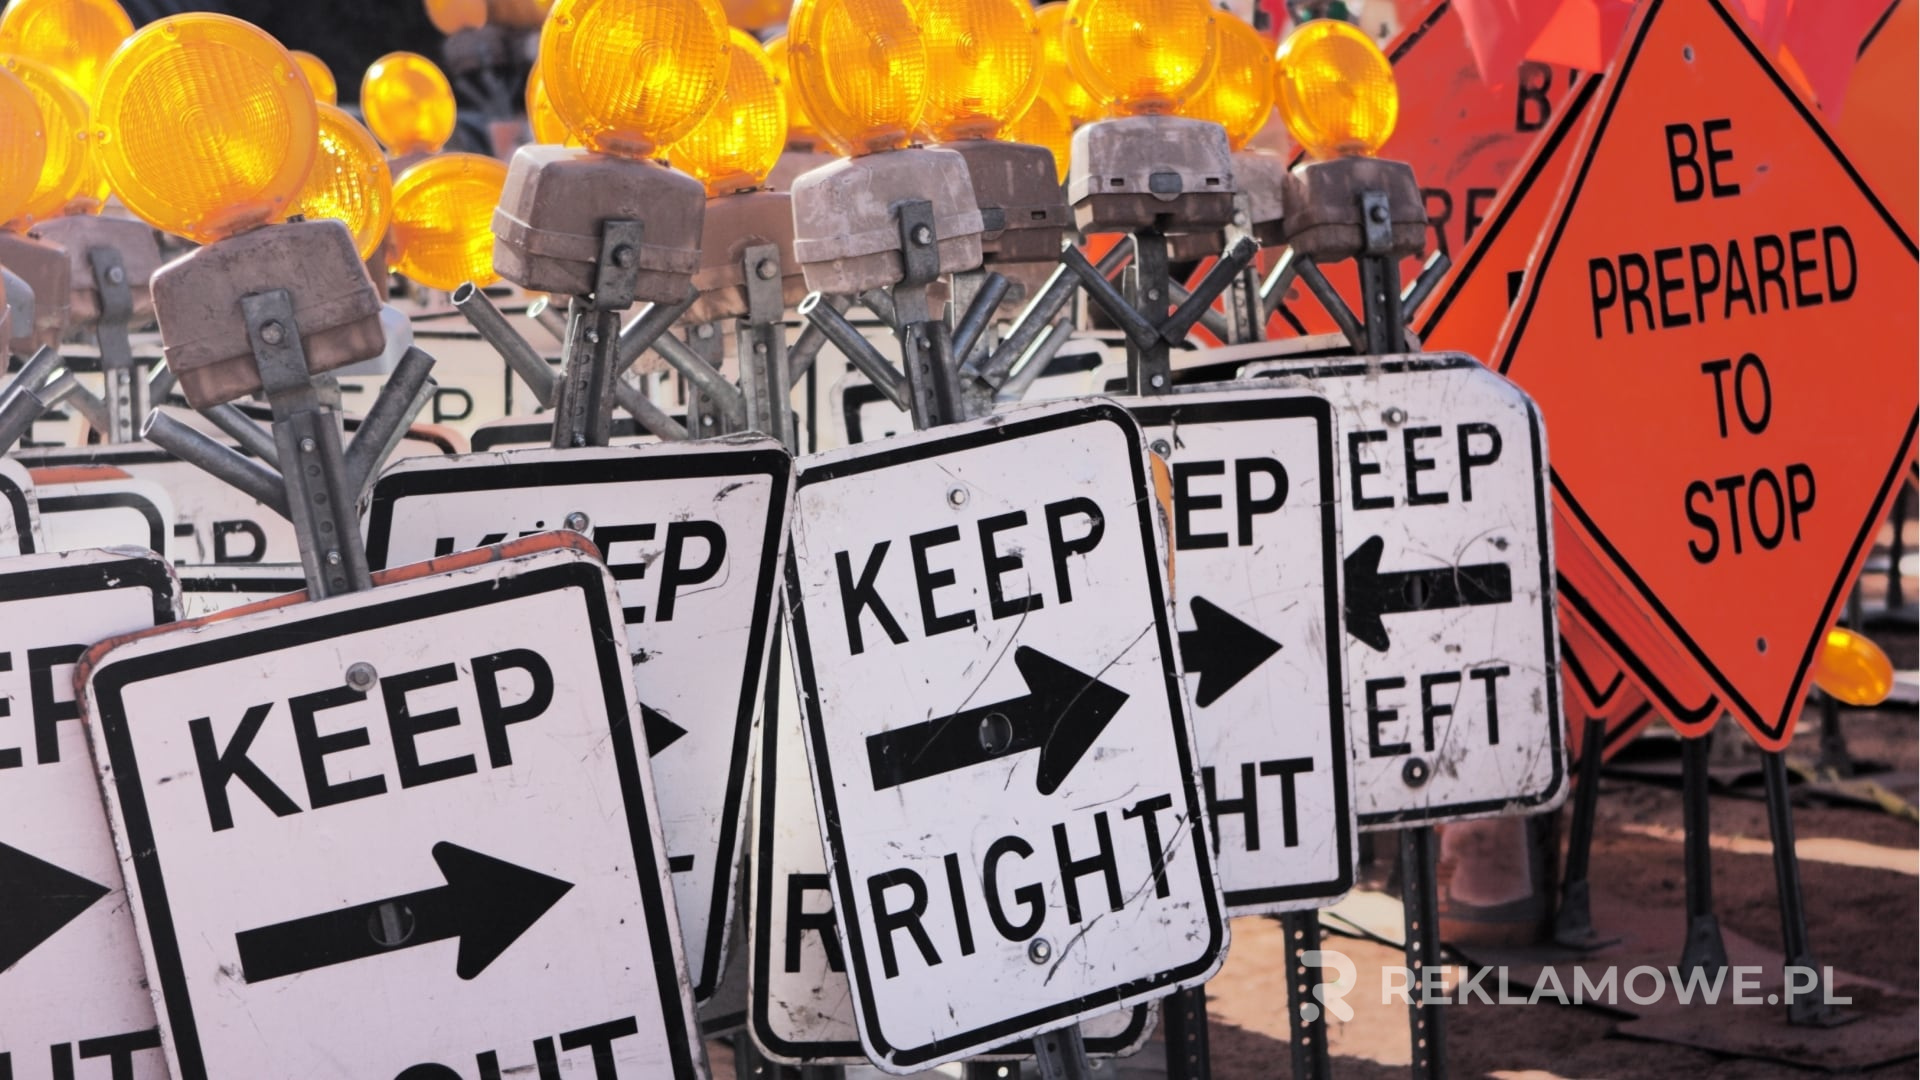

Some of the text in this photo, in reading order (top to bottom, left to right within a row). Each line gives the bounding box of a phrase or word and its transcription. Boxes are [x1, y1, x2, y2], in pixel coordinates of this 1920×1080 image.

[1665, 119, 1740, 203] BE
[1589, 225, 1858, 339] PREPARED
[1701, 353, 1773, 438] TO
[1348, 423, 1502, 511] EEP
[1684, 463, 1817, 564] STOP
[835, 497, 1105, 656] KEEP
[188, 648, 555, 832] KEEP
[1366, 666, 1510, 758] EFT
[867, 793, 1174, 980] RIGHT
